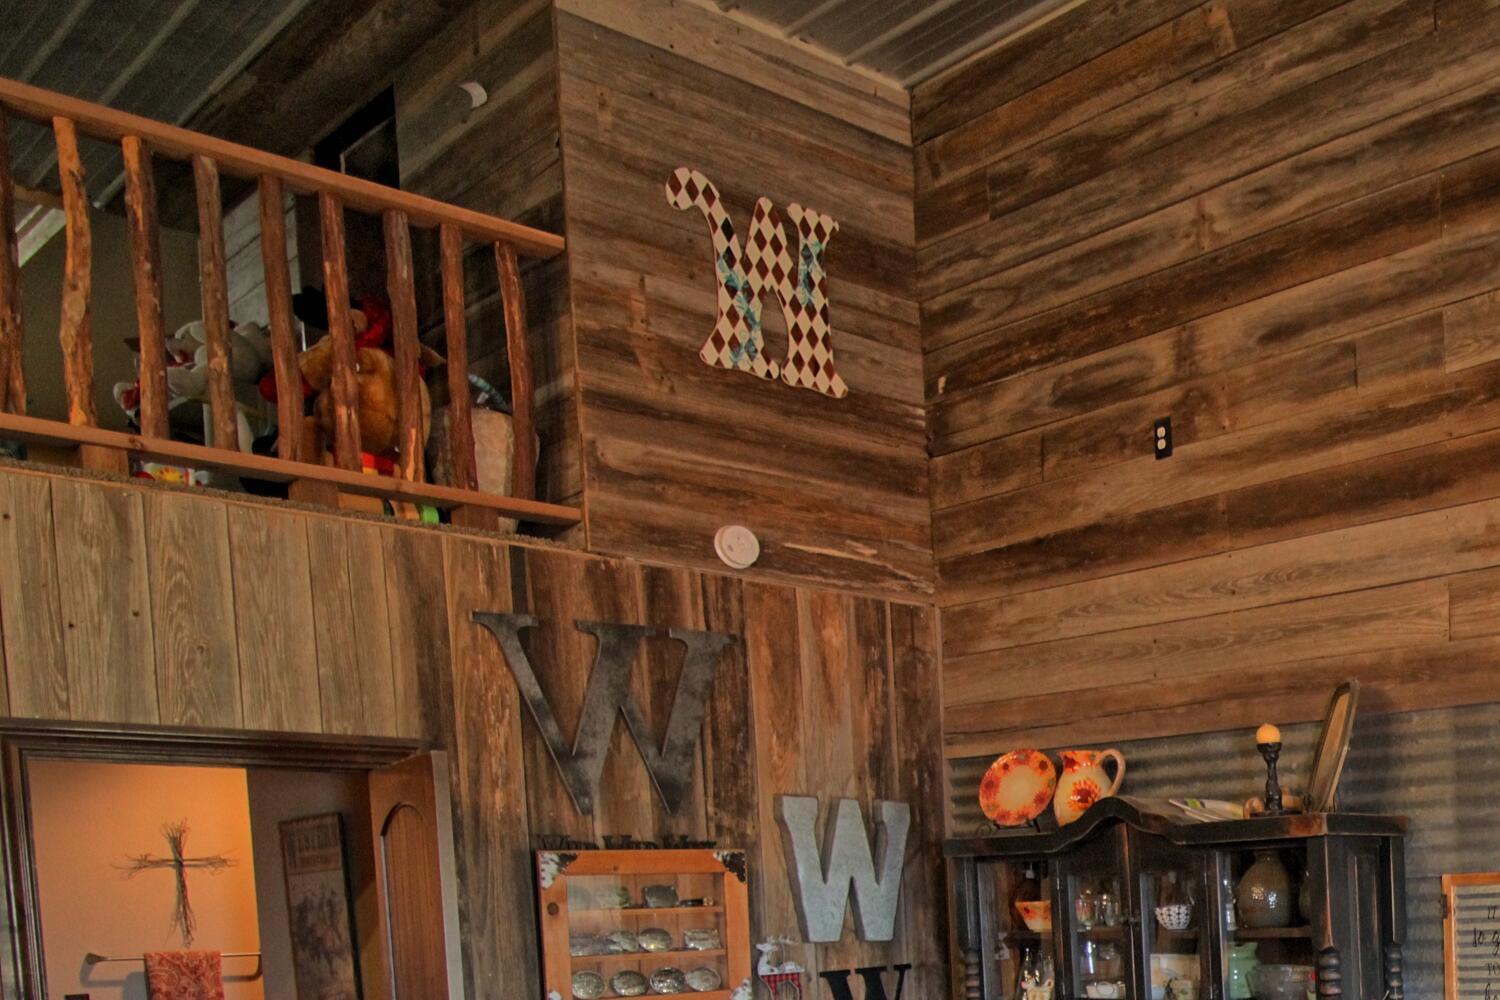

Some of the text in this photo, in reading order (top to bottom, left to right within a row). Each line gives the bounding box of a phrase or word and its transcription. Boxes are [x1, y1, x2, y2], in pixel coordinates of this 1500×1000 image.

[470, 609, 738, 816] W
[774, 794, 911, 942] W
[1472, 927, 1485, 947] so
[1486, 904, 1498, 919] IT
